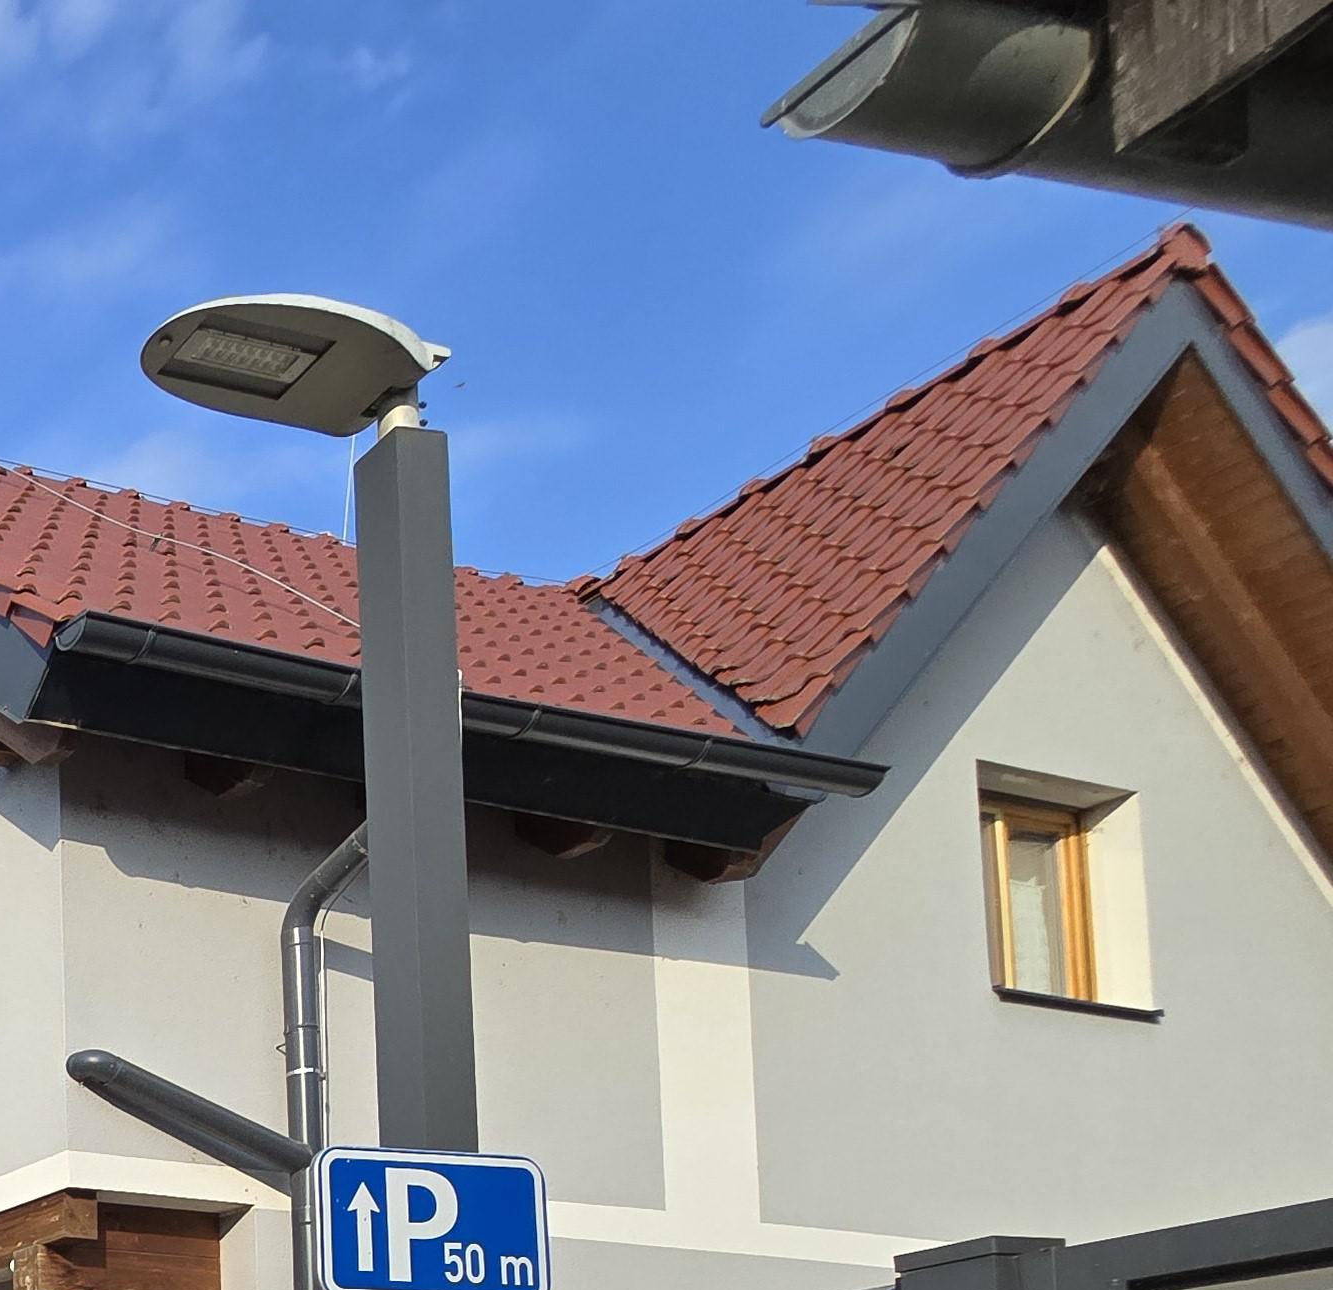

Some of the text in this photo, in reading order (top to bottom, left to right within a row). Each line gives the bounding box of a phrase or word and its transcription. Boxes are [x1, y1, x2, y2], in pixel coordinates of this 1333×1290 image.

[385, 1167, 458, 1283] P
[443, 1242, 534, 1286] 50 m
